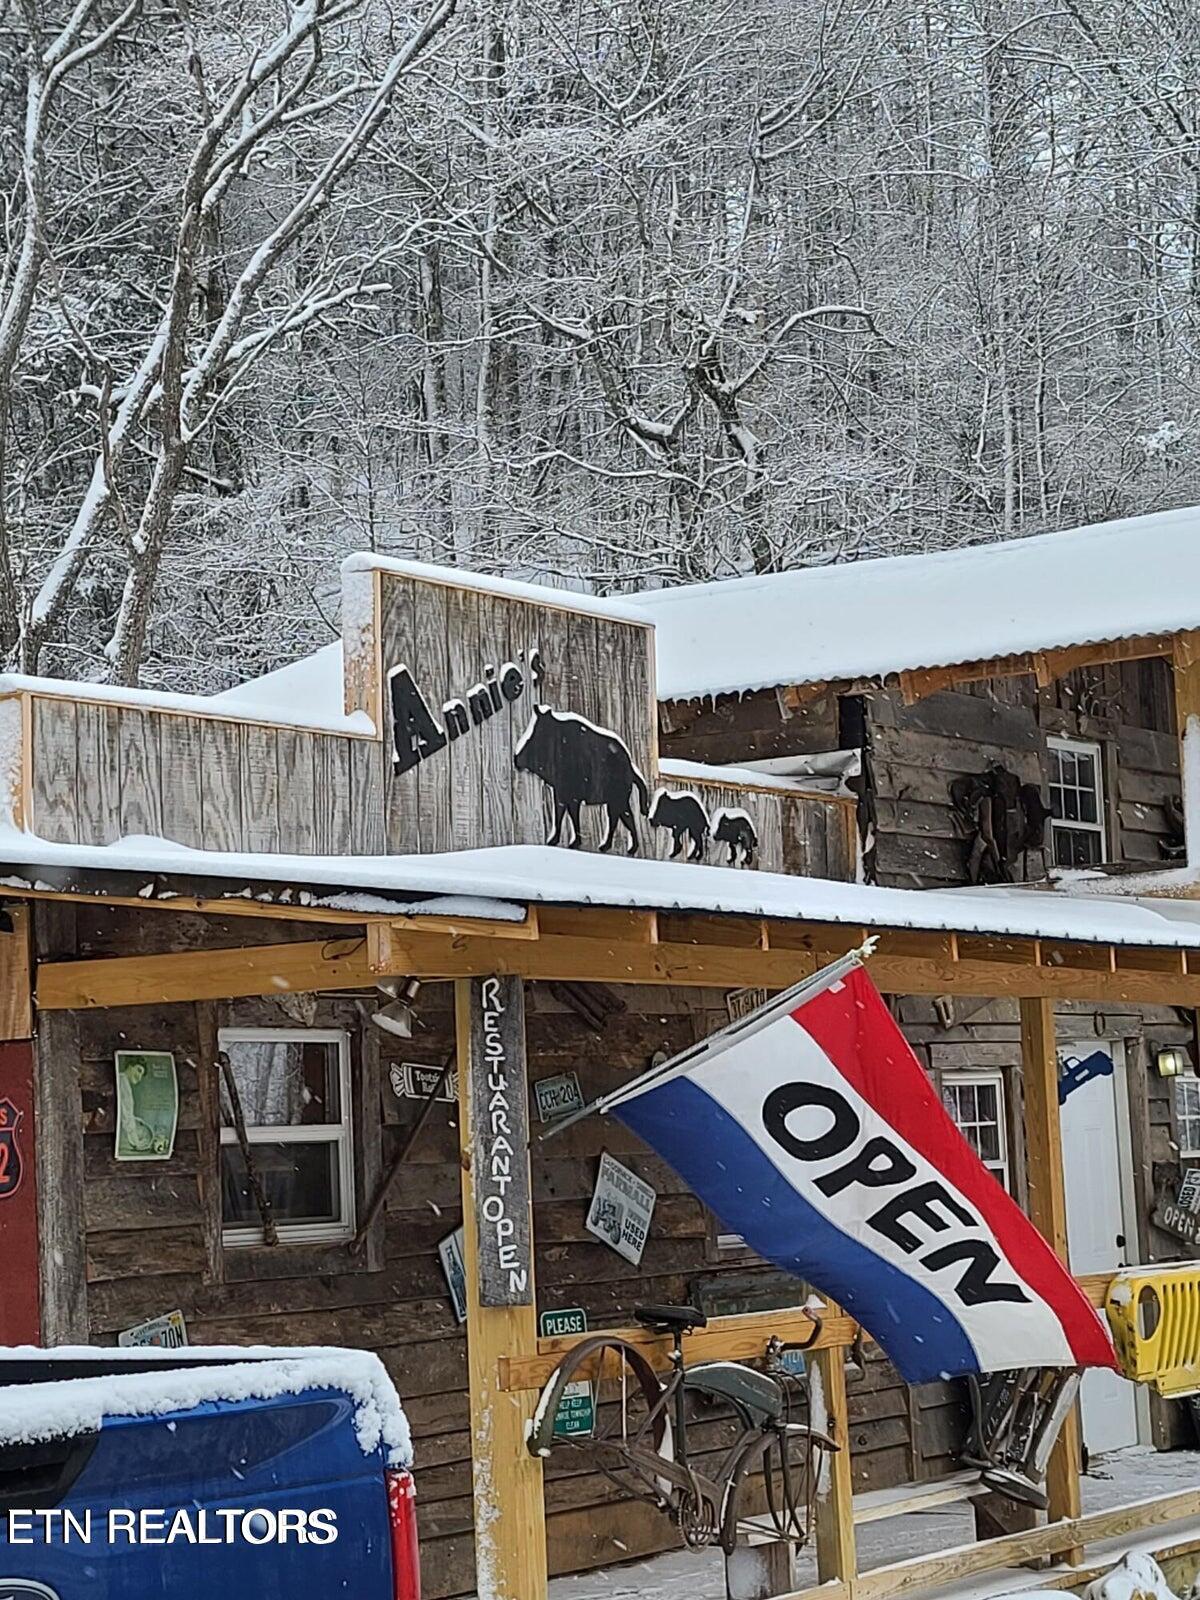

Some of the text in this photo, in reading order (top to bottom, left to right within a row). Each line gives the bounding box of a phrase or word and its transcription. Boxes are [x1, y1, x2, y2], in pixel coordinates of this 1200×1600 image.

[387, 648, 546, 777] Annie's
[480, 977, 528, 1294] RESTUARANT OPEN
[762, 1081, 1033, 1307] OPEN
[625, 1217, 645, 1241] USED
[1164, 1206, 1195, 1238] OPEN
[622, 1228, 642, 1252] HERE
[546, 1315, 582, 1336] PLEASE
